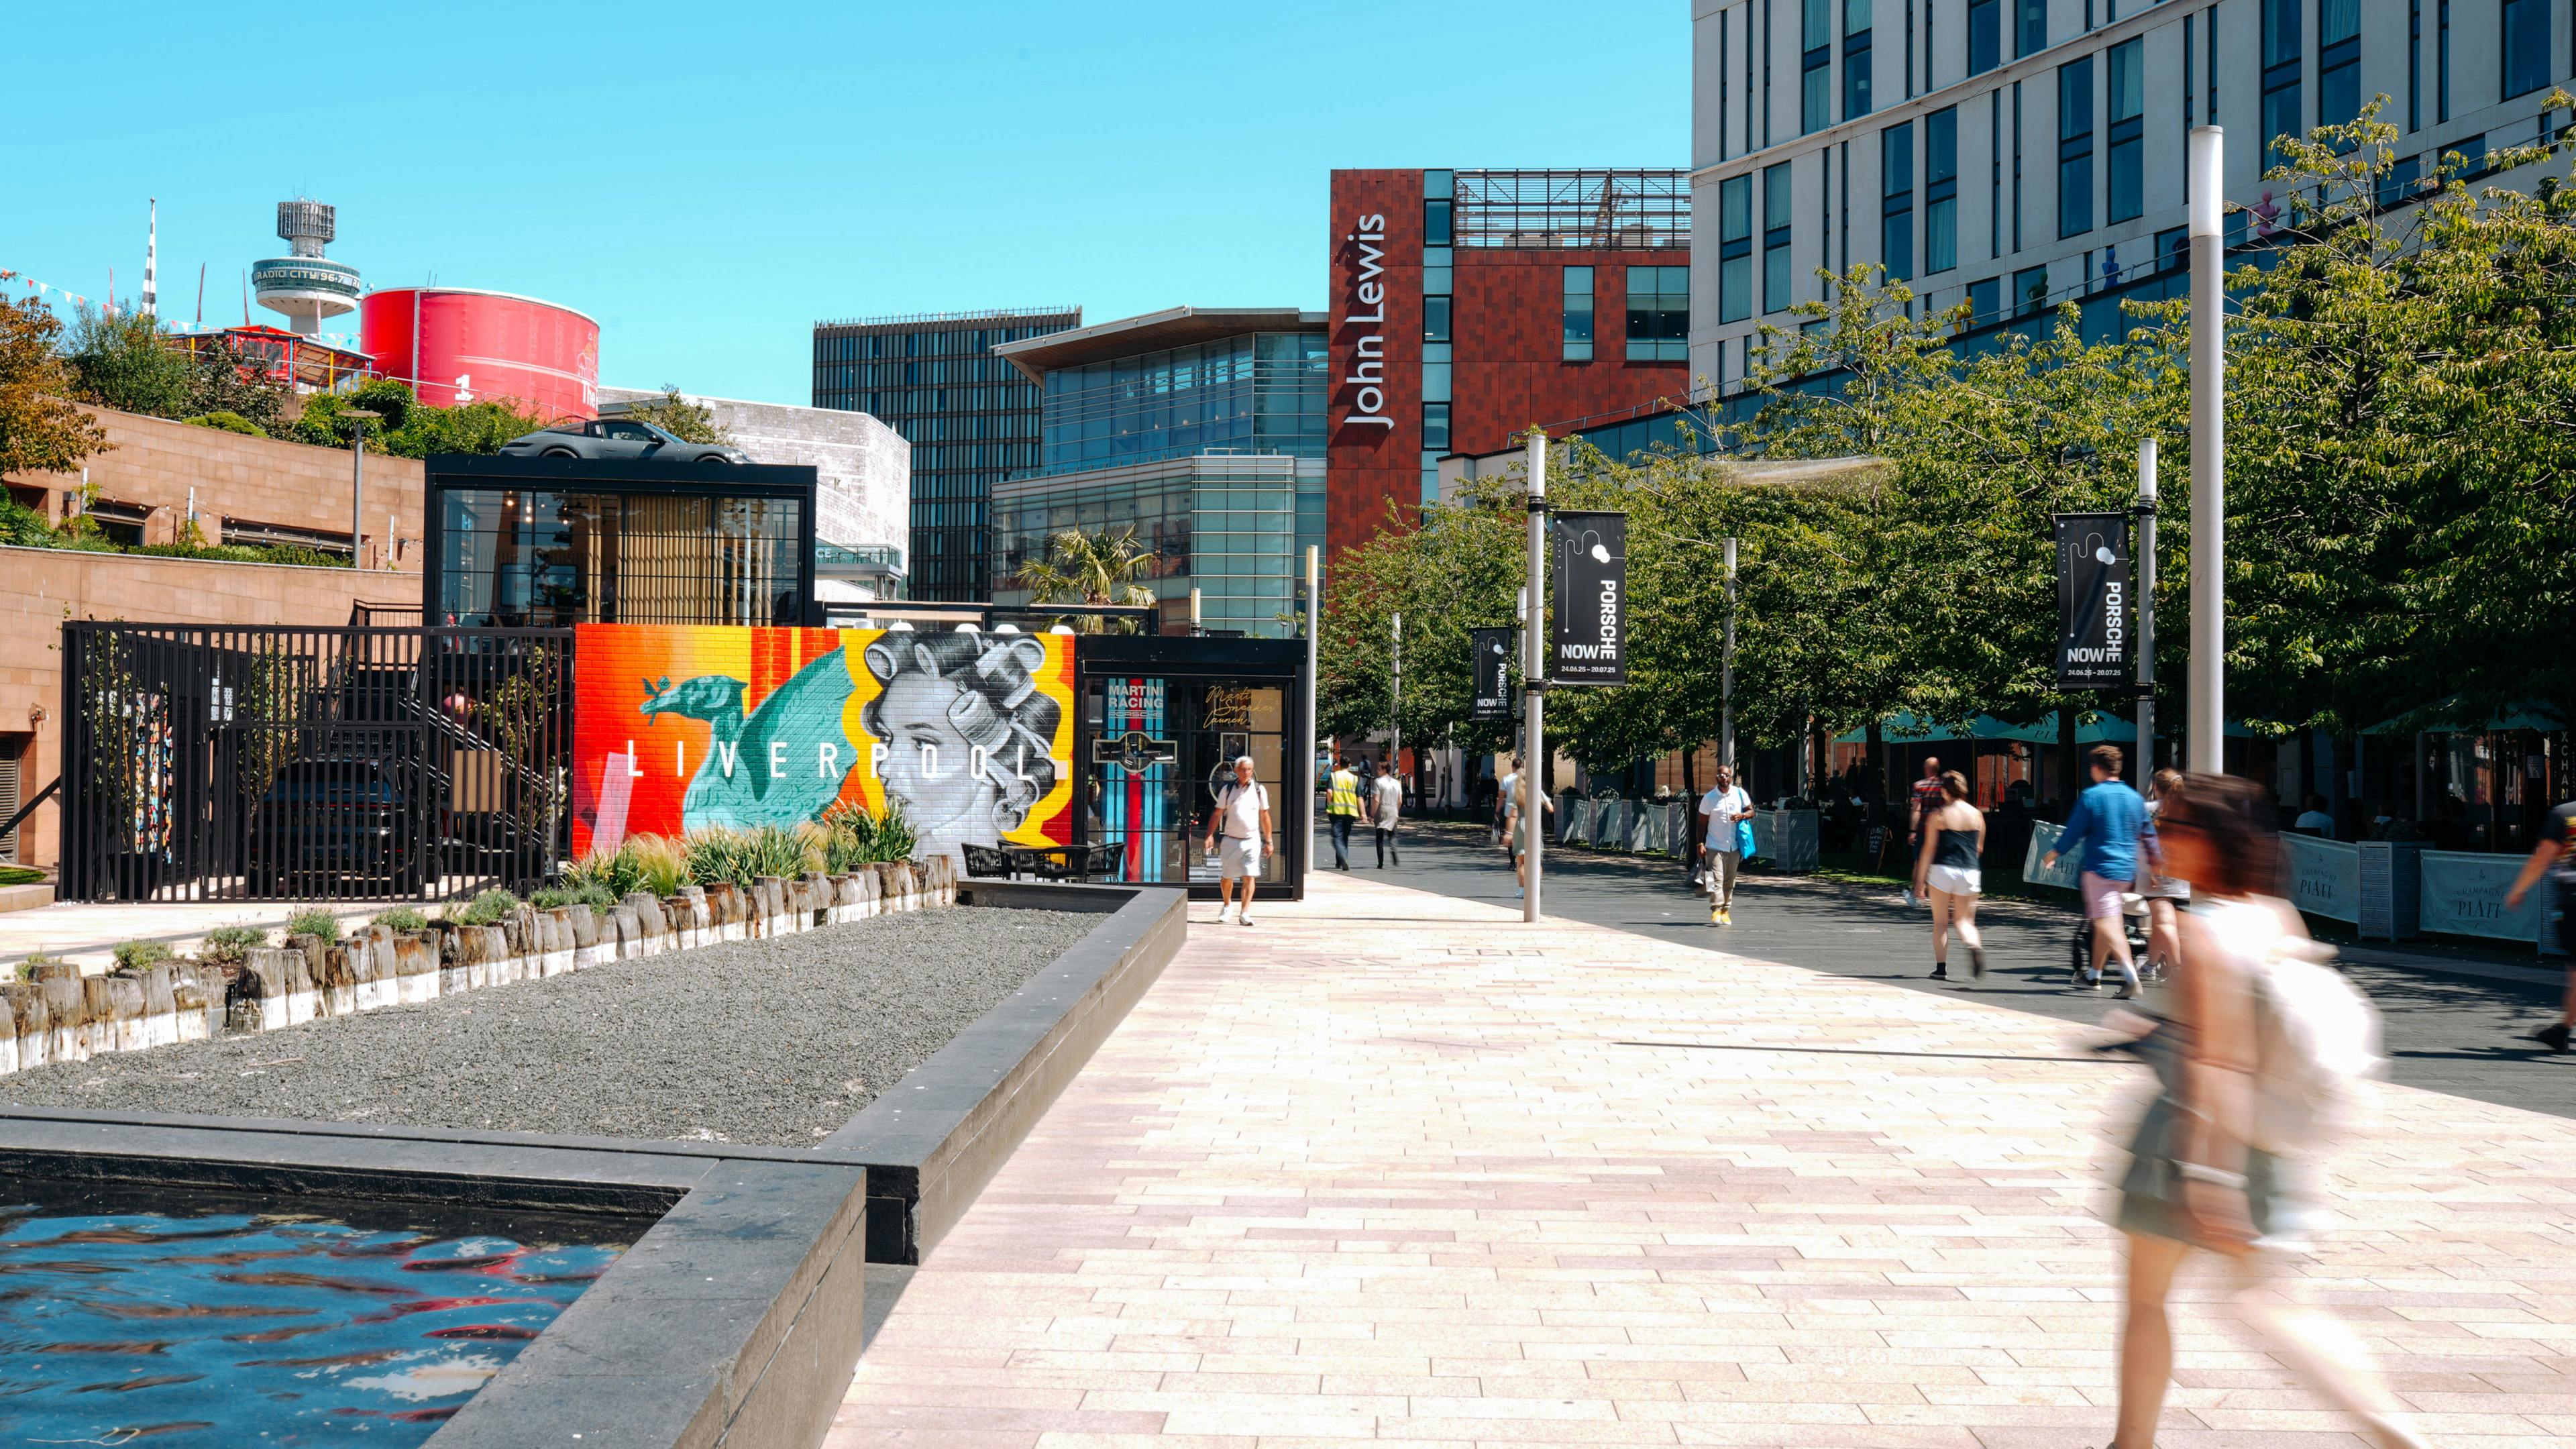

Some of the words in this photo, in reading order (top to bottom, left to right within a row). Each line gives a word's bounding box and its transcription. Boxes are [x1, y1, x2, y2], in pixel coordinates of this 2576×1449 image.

[257, 270, 286, 279] RADIO
[290, 270, 317, 280] CITY
[1344, 214, 1385, 322] Lewis
[455, 374, 474, 400] 1
[1343, 336, 1395, 430] John
[1601, 580, 1617, 659] PORSCHE
[2106, 582, 2123, 662] PORSCHE
[1561, 644, 1599, 659] NOW
[2068, 647, 2105, 663] NOW
[1108, 685, 1164, 696] MARTINI
[1498, 663, 1507, 706] PORSCHE
[1108, 698, 1164, 708] RACING
[1477, 698, 1498, 707] NOW
[628, 740, 1034, 781] LIVERPOOL
